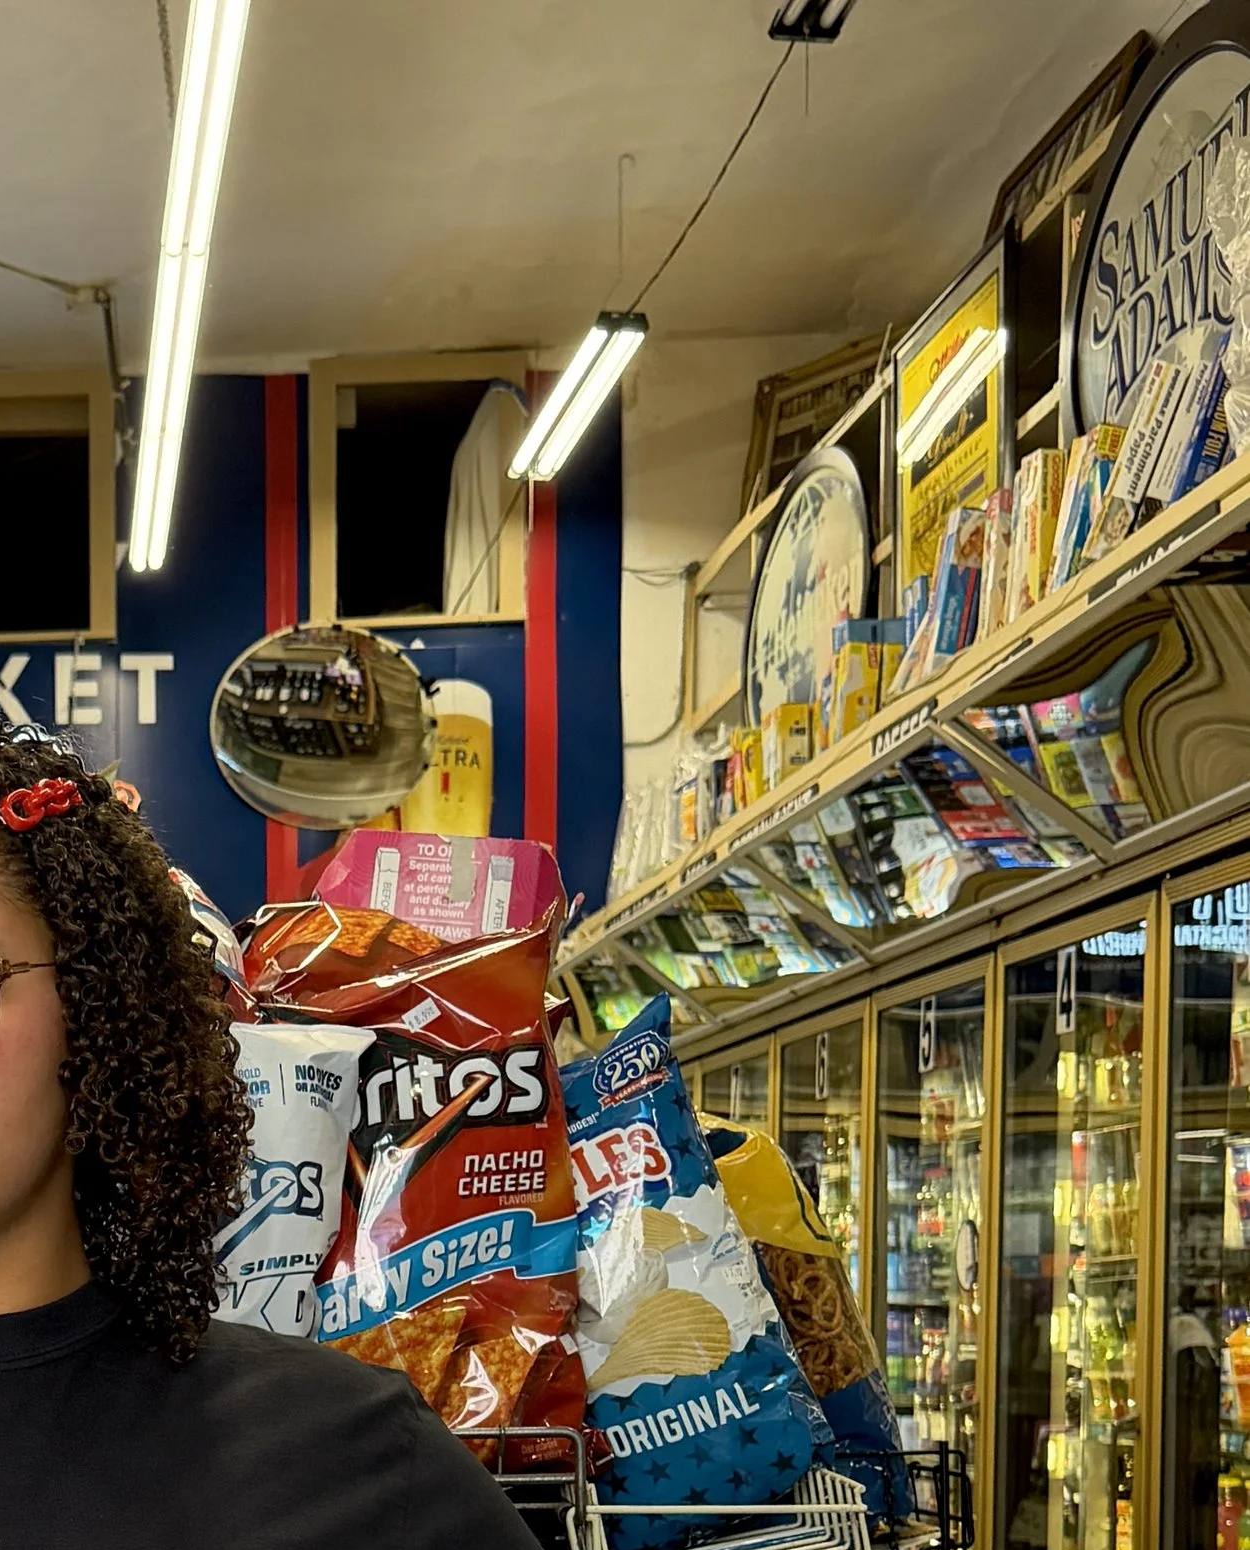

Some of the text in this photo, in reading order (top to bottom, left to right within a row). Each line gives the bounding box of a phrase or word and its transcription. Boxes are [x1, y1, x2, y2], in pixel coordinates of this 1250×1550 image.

[434, 749, 481, 770] TRA
[417, 843, 437, 857] TO
[409, 860, 452, 873] Separat
[414, 907, 427, 917] as
[430, 907, 465, 919] shown
[294, 1064, 343, 1092] NO DYES
[605, 1042, 661, 1091] 250
[352, 1050, 546, 1130] ritos
[464, 1149, 544, 1174] NACHO
[459, 1171, 545, 1196] CHEESE
[499, 1191, 544, 1206] FLAVORED
[239, 1252, 324, 1277] SIMPLY
[421, 1220, 515, 1289] Size!
[606, 1382, 760, 1459] ORIGINAL
